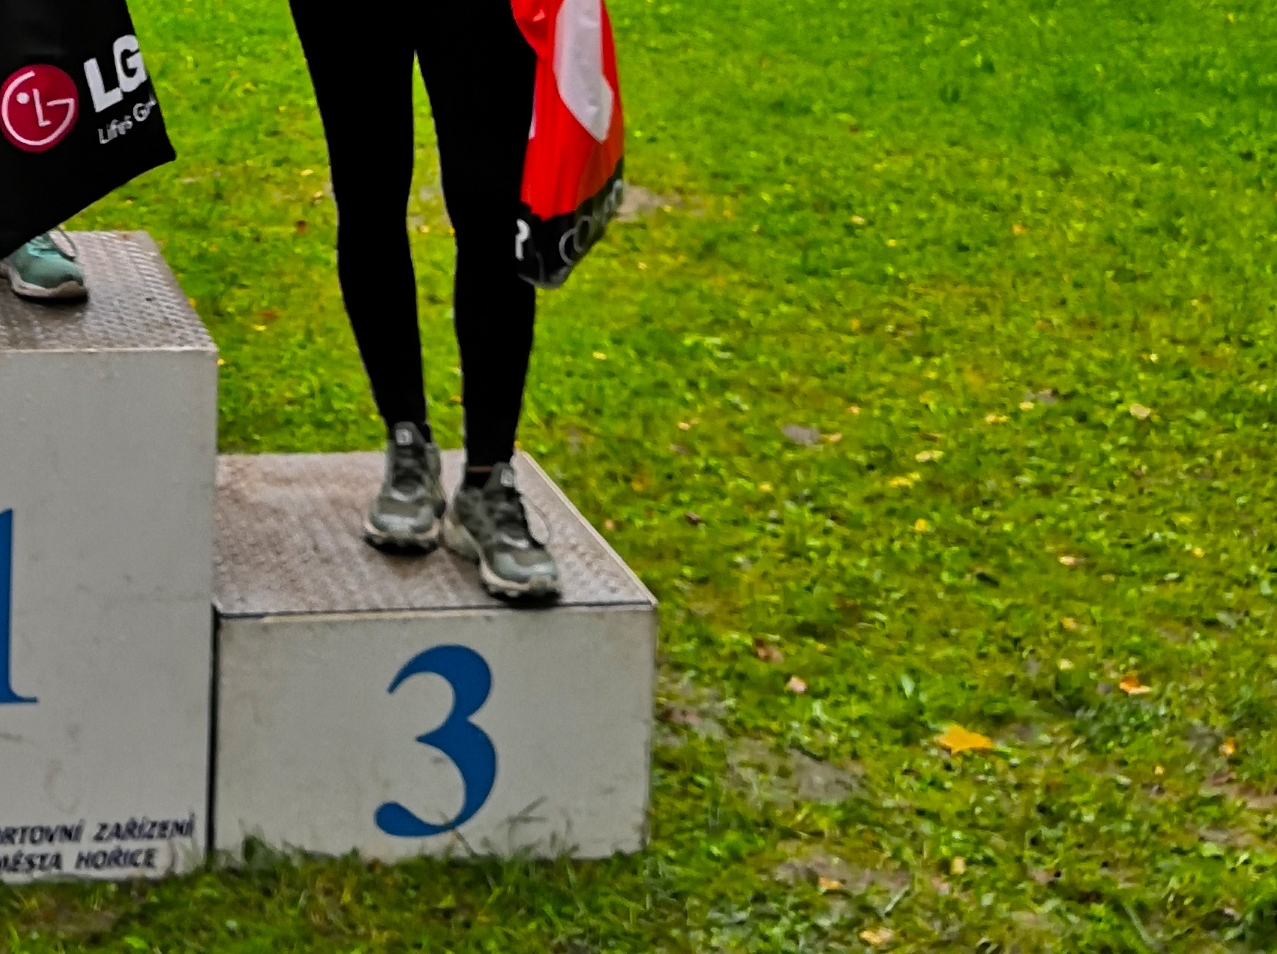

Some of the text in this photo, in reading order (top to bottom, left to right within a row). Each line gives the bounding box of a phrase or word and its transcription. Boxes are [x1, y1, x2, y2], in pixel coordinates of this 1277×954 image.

[84, 34, 148, 113] LG
[374, 644, 497, 838] 3
[93, 810, 196, 842] ZAŘÍZENÍ
[75, 847, 159, 870] HOŘICE
